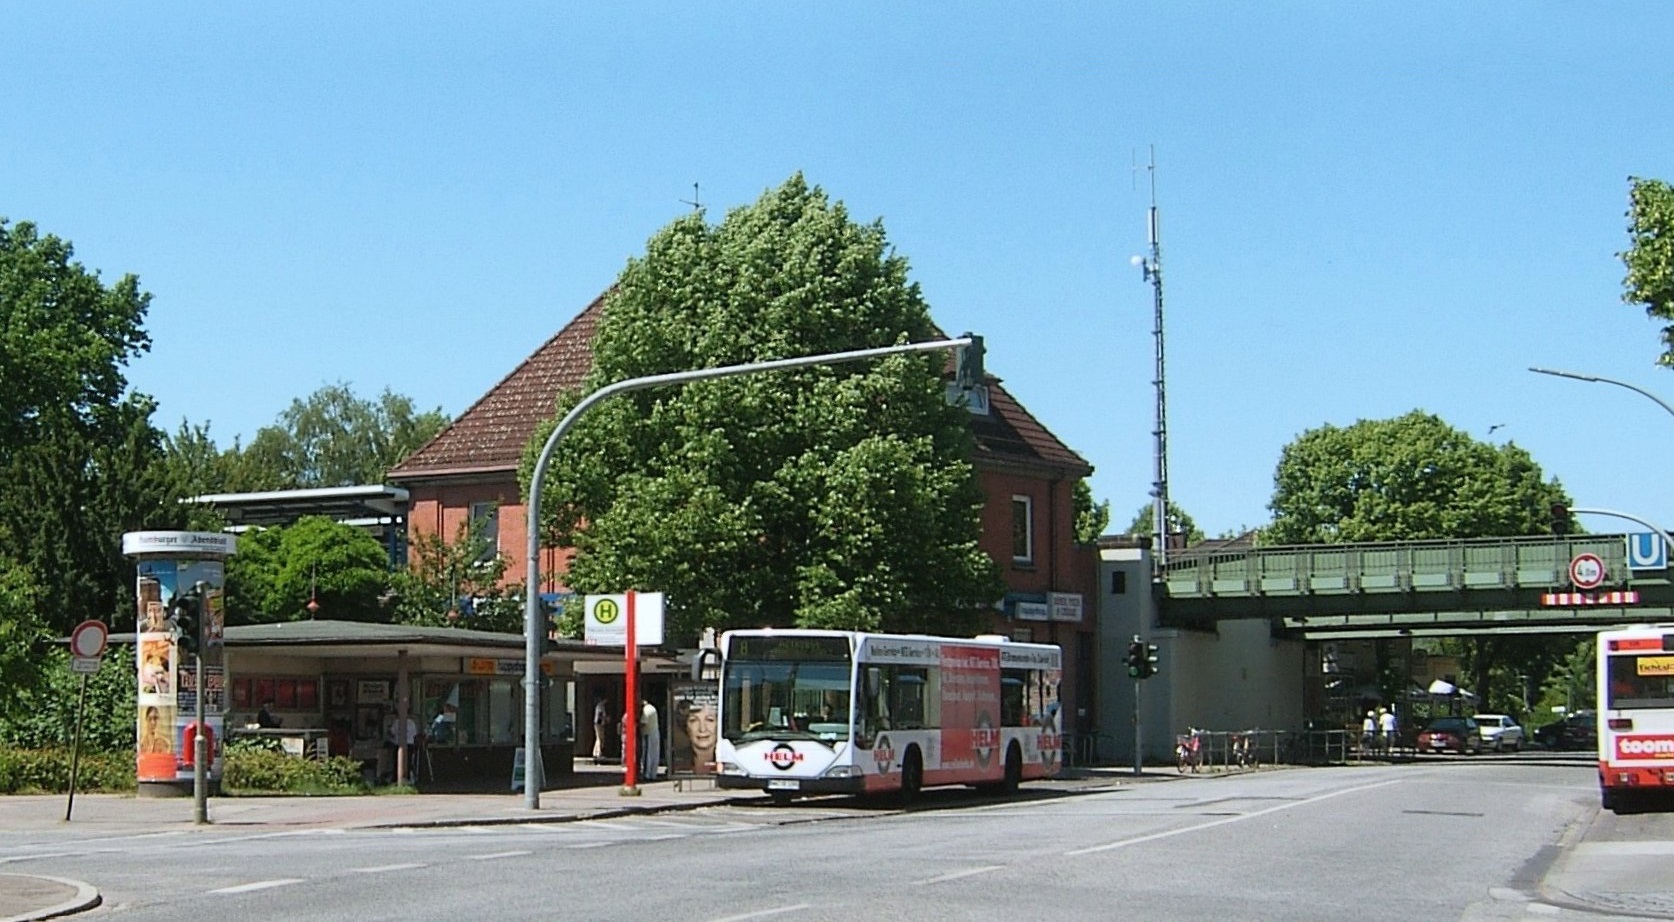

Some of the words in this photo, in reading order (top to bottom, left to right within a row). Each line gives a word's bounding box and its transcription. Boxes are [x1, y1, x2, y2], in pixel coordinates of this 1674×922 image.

[1632, 534, 1660, 566] U
[600, 604, 612, 618] H
[971, 729, 1000, 748] HELM
[1037, 734, 1062, 750] HELM
[1619, 738, 1674, 754] toom
[764, 752, 804, 761] HELM
[874, 749, 895, 762] HELM
